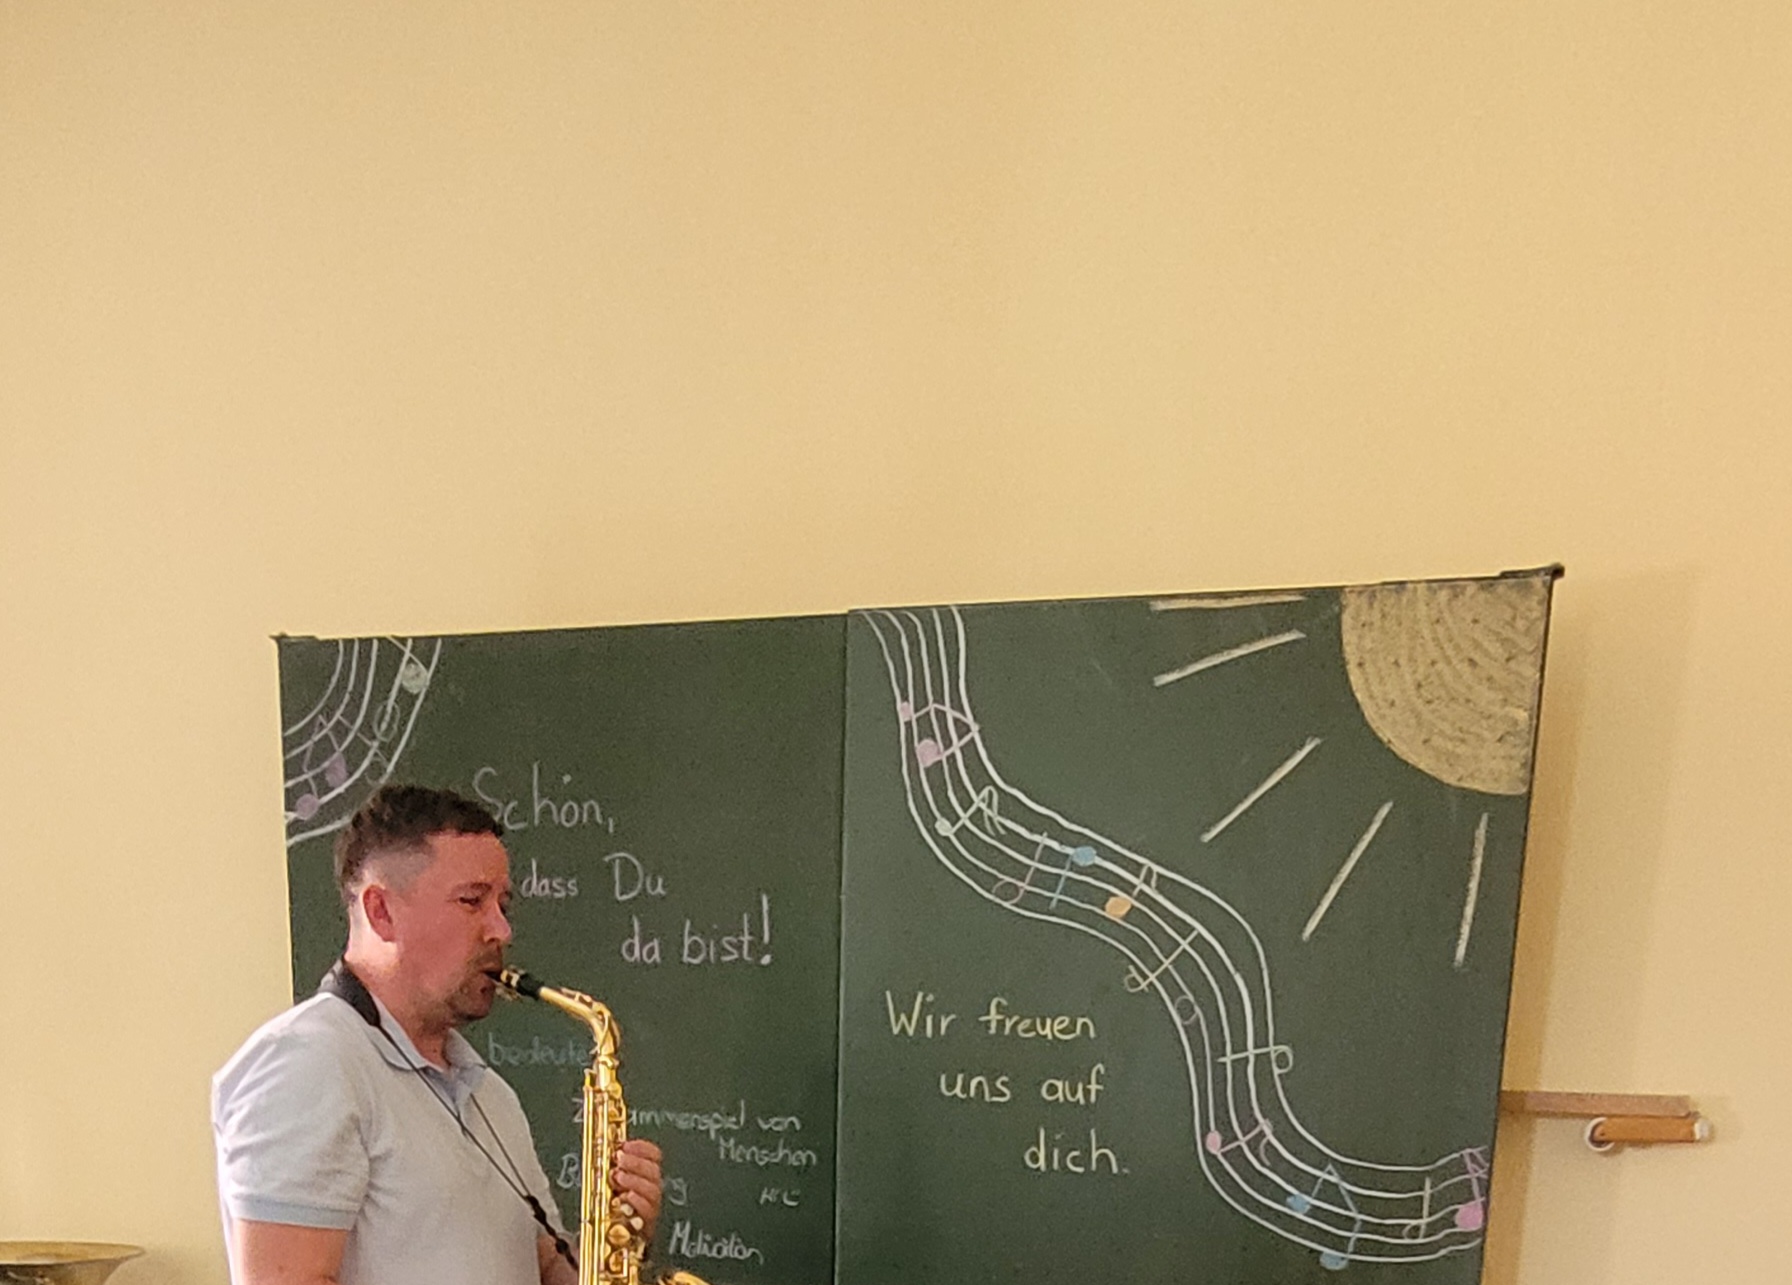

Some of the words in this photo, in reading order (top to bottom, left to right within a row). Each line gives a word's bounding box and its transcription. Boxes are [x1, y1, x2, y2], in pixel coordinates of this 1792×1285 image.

[520, 858, 579, 899] dass
[603, 851, 667, 901] Du
[621, 914, 661, 964] da
[682, 893, 773, 966] bist!
[885, 990, 957, 1038] Wir
[978, 997, 1096, 1040] freuen
[940, 1072, 1012, 1103] uns
[1040, 1062, 1106, 1106] auf
[757, 1114, 803, 1133] von
[1023, 1127, 1131, 1175] dich.
